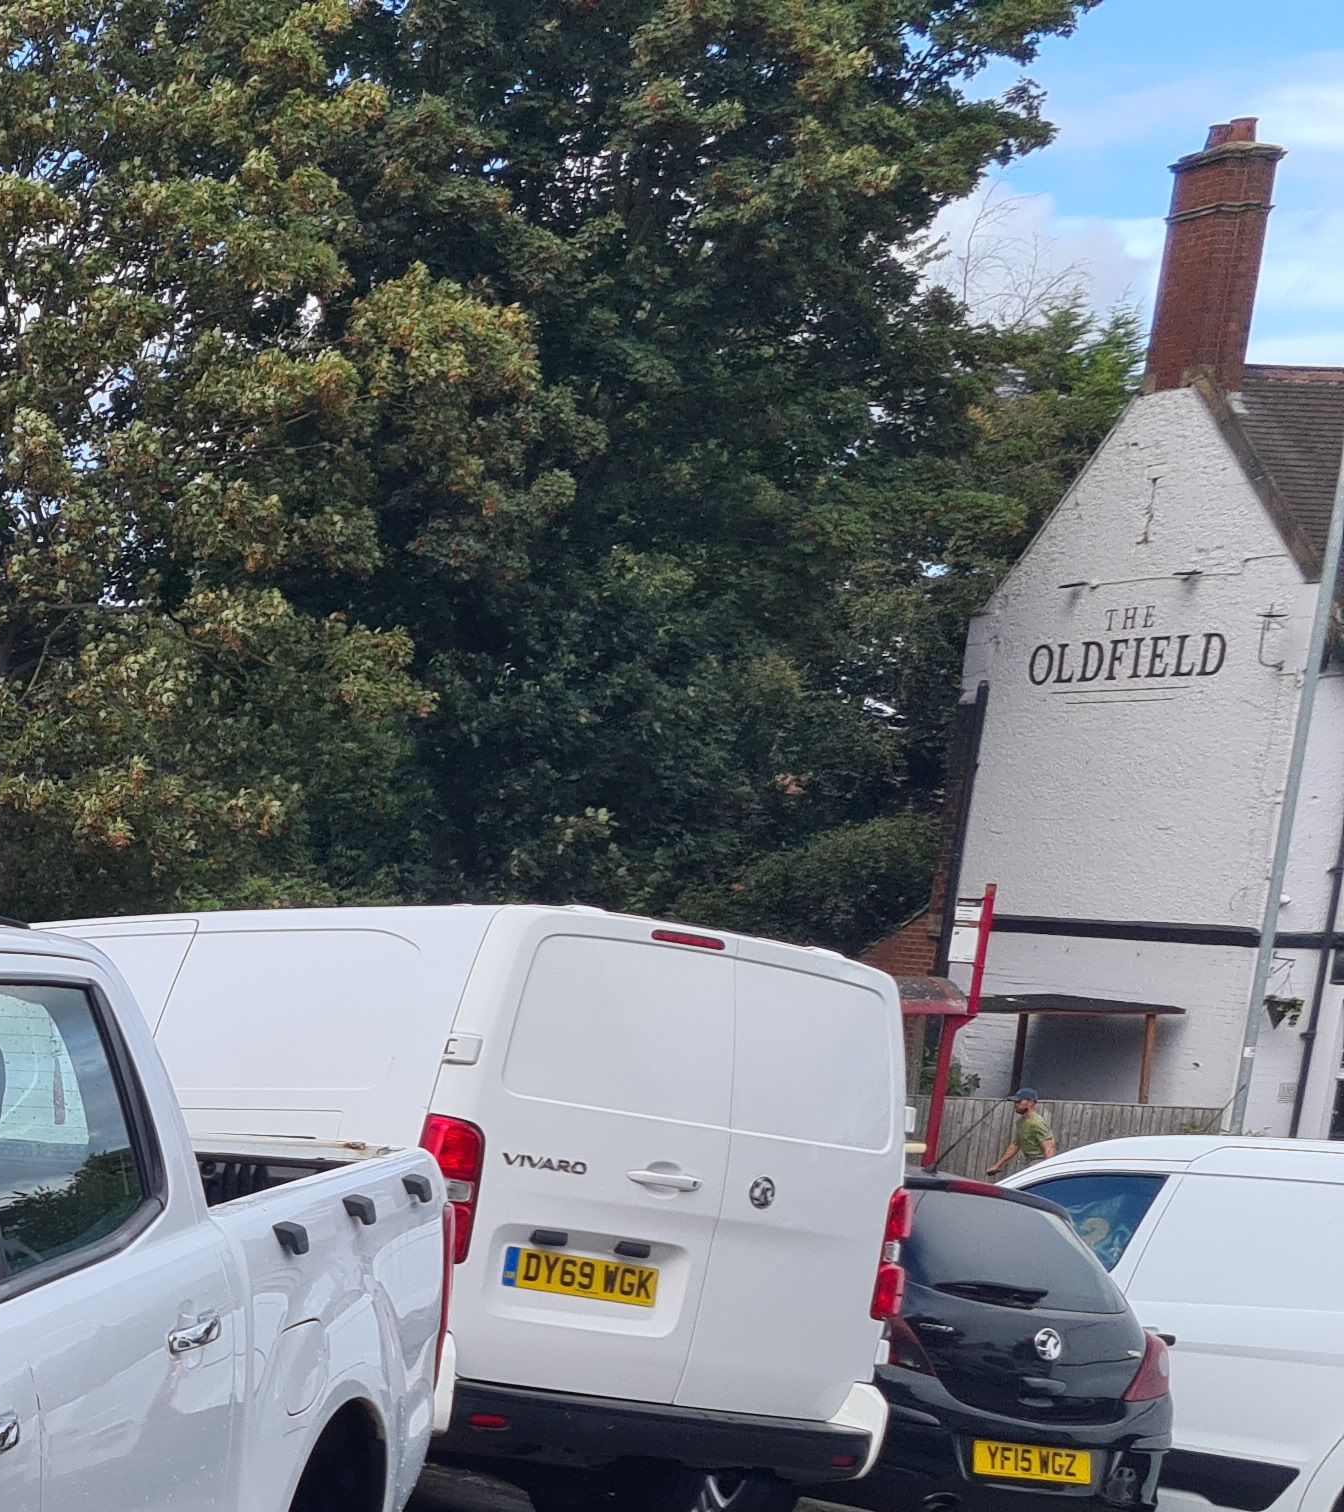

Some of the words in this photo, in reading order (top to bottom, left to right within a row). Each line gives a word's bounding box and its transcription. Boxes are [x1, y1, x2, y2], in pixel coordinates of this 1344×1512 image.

[1105, 605, 1156, 632] THE
[1028, 632, 1227, 686] OLDFIELD
[502, 1152, 587, 1175] VIVARO
[522, 1252, 596, 1291] DY69
[603, 1264, 656, 1300] WGK
[987, 1445, 1033, 1473] YF15
[1037, 1450, 1078, 1478] WGZ
